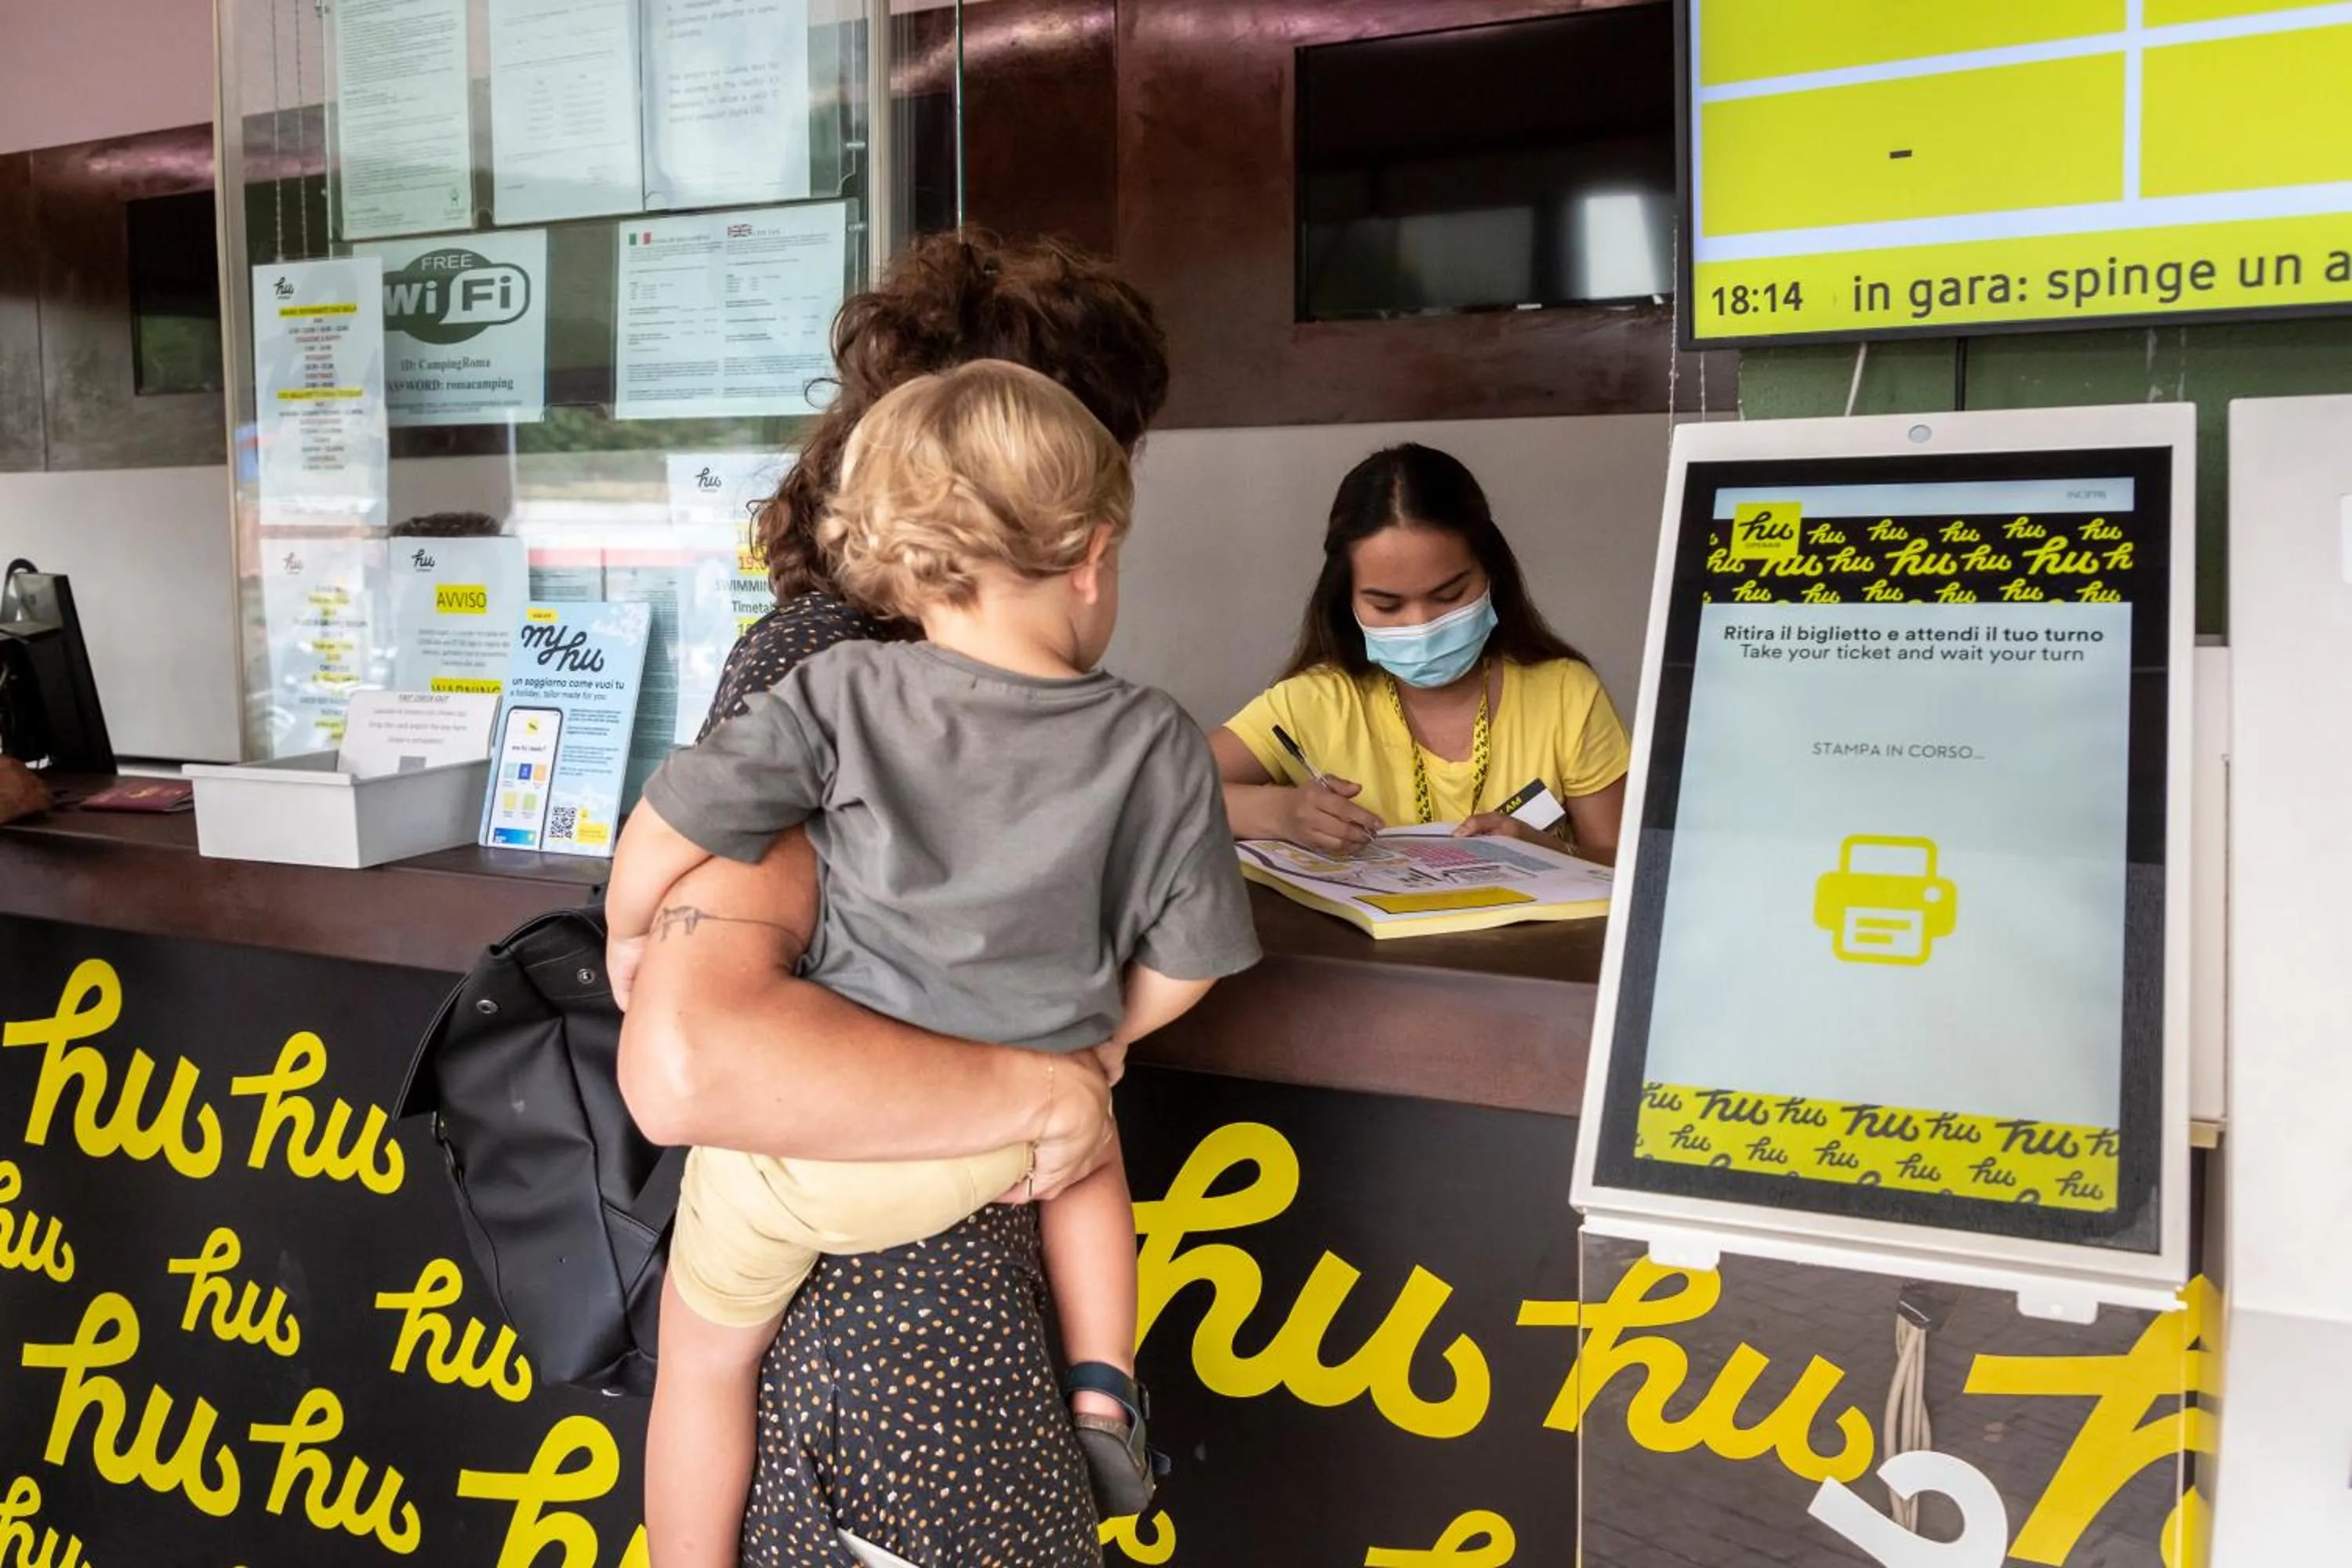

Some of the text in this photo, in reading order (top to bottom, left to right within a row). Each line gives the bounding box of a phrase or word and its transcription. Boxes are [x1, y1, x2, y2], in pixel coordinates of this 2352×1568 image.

[421, 253, 474, 271] FREE
[1853, 275, 1891, 313] in
[1908, 273, 2028, 319] gara:
[2047, 256, 2217, 308] spinge
[2238, 253, 2303, 289] un
[1711, 281, 1804, 316] 18:14
[387, 378, 443, 392] ASSWORD:
[695, 466, 722, 489] hu
[1739, 511, 1795, 542] hu
[411, 549, 435, 567] hu
[1827, 546, 1875, 572] hu
[1885, 538, 1958, 576] hu
[1961, 544, 2012, 572] hu
[2022, 535, 2100, 575] hu
[437, 592, 488, 608] AVVISO
[1724, 626, 2103, 644] Ritira il biglietto e attendi il tuo turno
[1740, 644, 2084, 664] Take your ticket and wait your turn
[512, 678, 523, 687] un
[524, 677, 567, 689] soggiorno
[595, 680, 614, 690] vuoi
[615, 681, 626, 690] tu
[1812, 742, 1881, 757] STAMPA
[1886, 744, 1904, 757] IN
[2, 958, 405, 1195] hu hu
[168, 1227, 301, 1356] hu
[375, 1258, 533, 1403] hu
[1132, 1122, 1491, 1439] hu
[1515, 1254, 1875, 1485] hu
[22, 1292, 241, 1517] hu
[249, 1388, 421, 1555] hu
